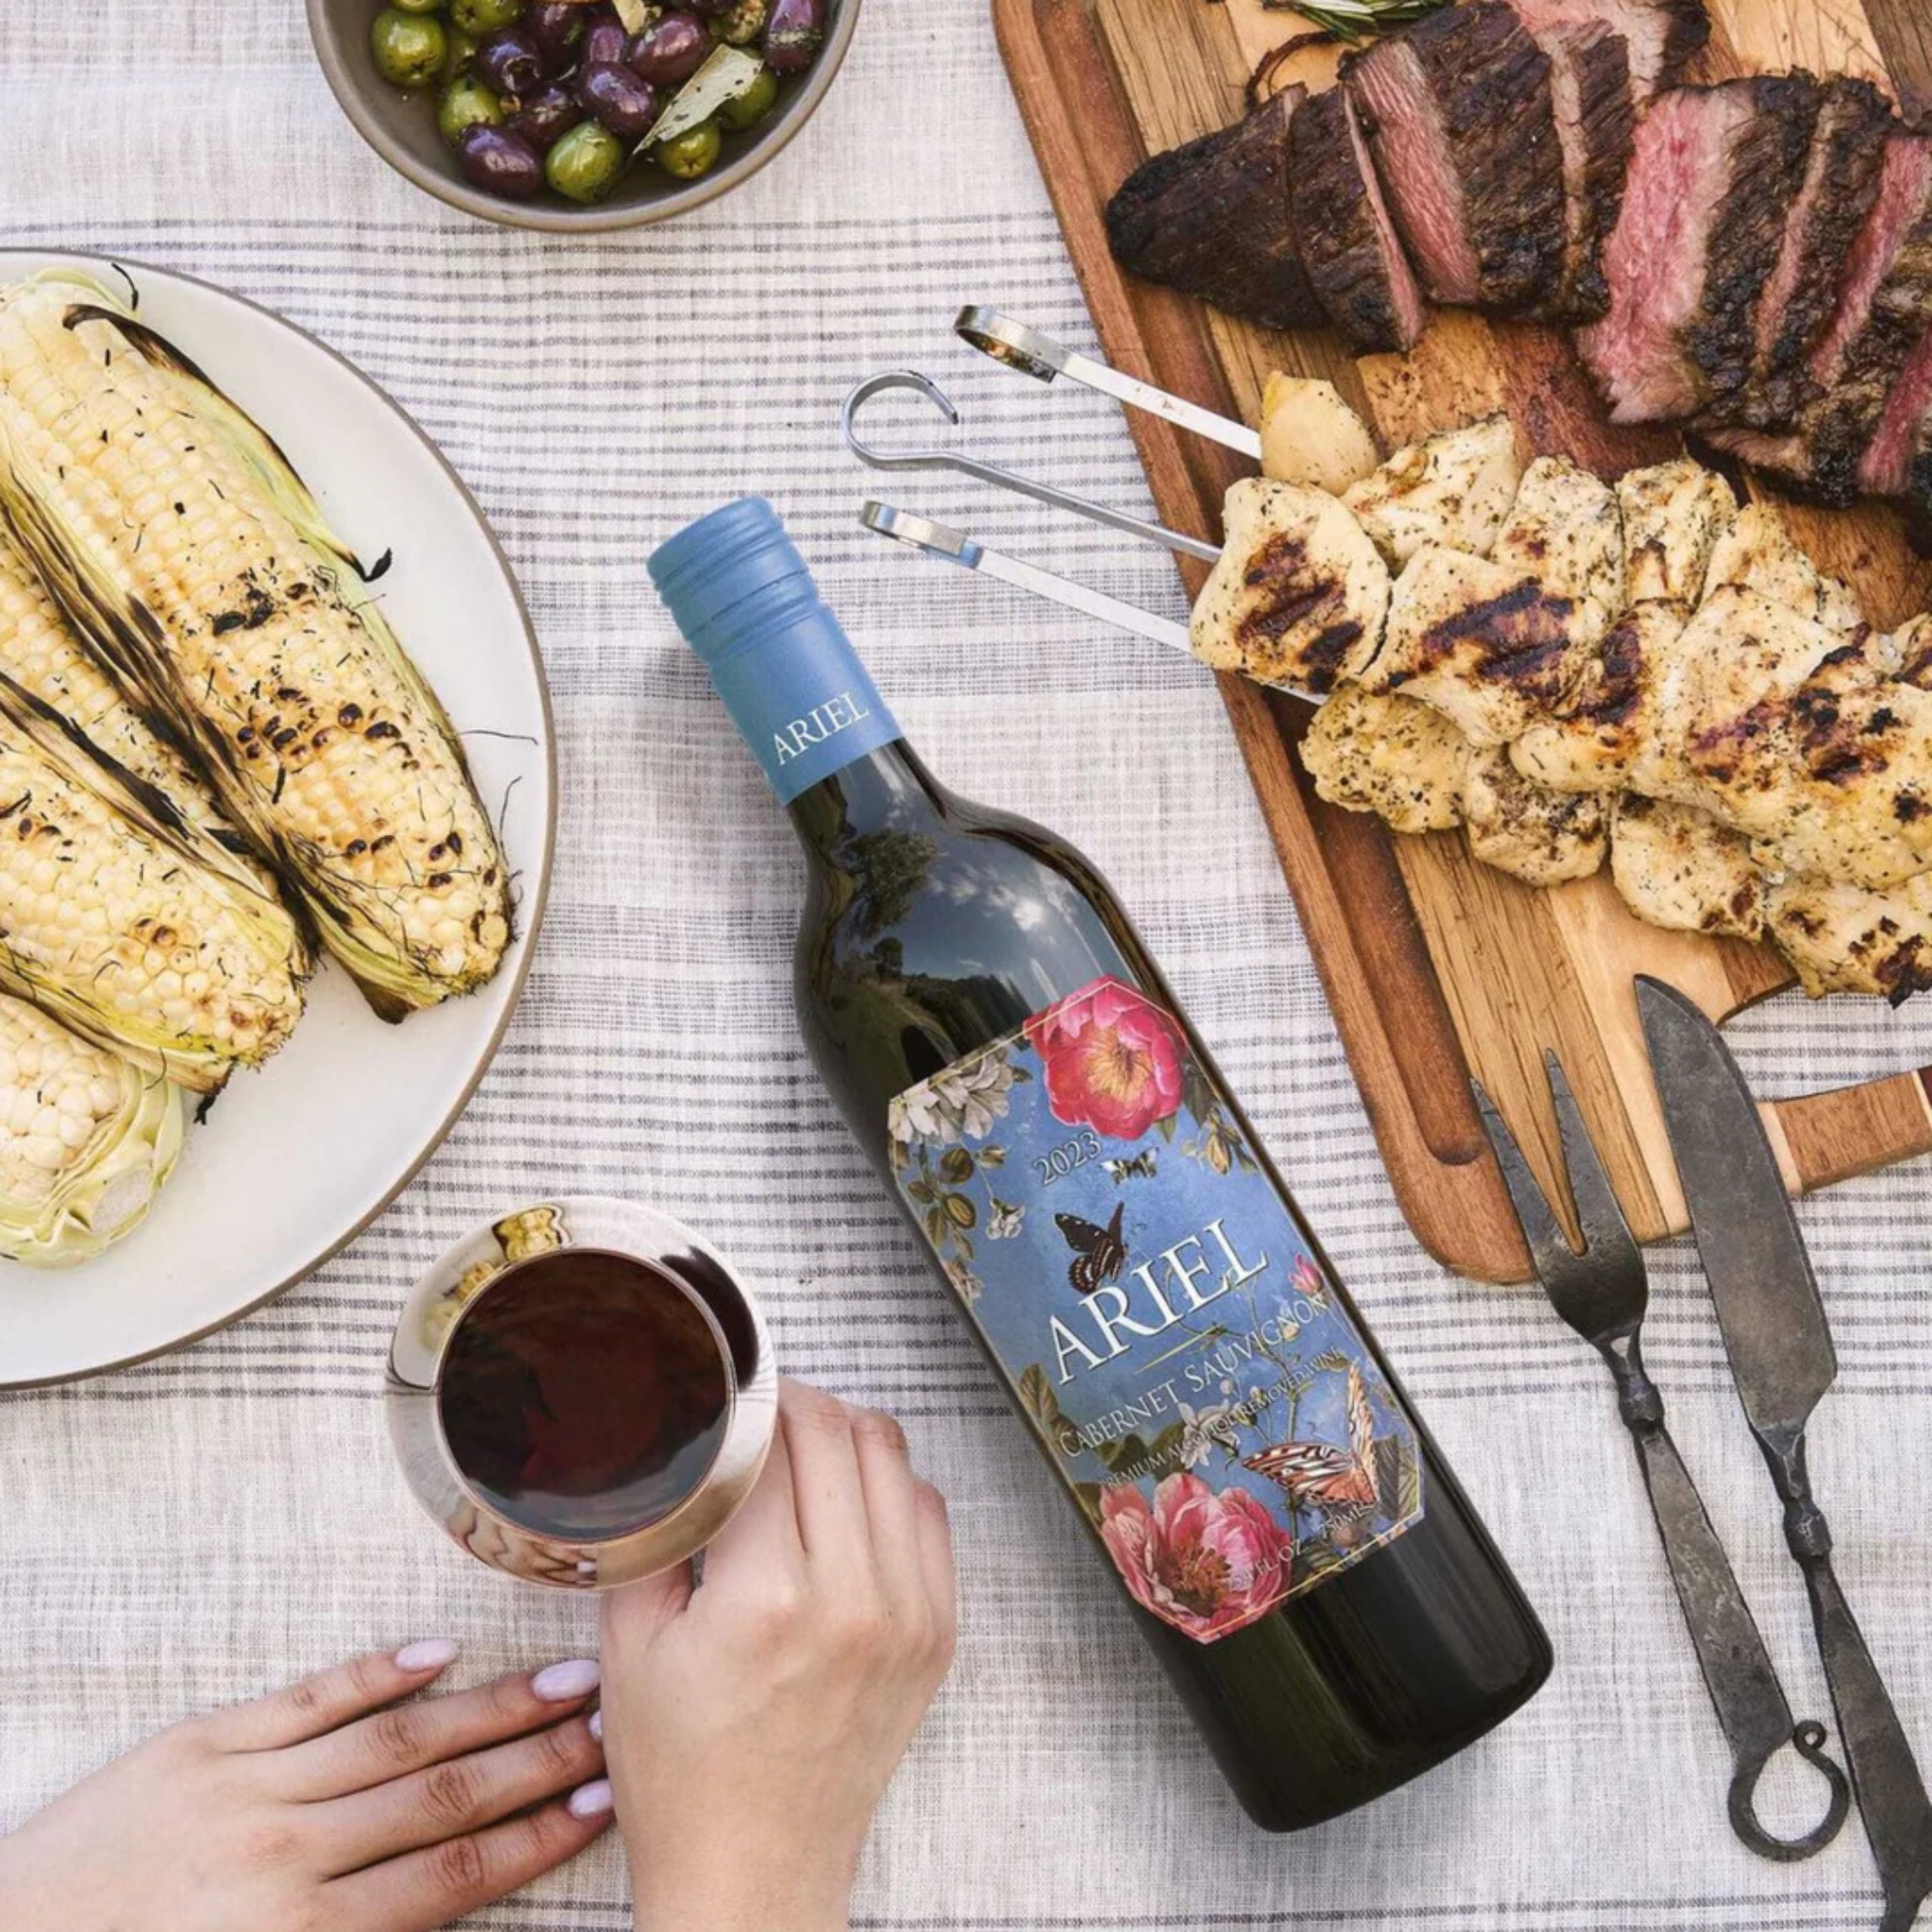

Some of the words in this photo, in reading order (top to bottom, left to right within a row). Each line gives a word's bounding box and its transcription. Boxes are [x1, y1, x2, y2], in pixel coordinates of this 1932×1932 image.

[771, 692, 870, 765] ARIEL
[1034, 1131, 1102, 1186] 2023
[1049, 1218, 1268, 1385] ARIEL
[1059, 1378, 1180, 1457] CABERNET
[1183, 1293, 1327, 1394] SAUVIGNON
